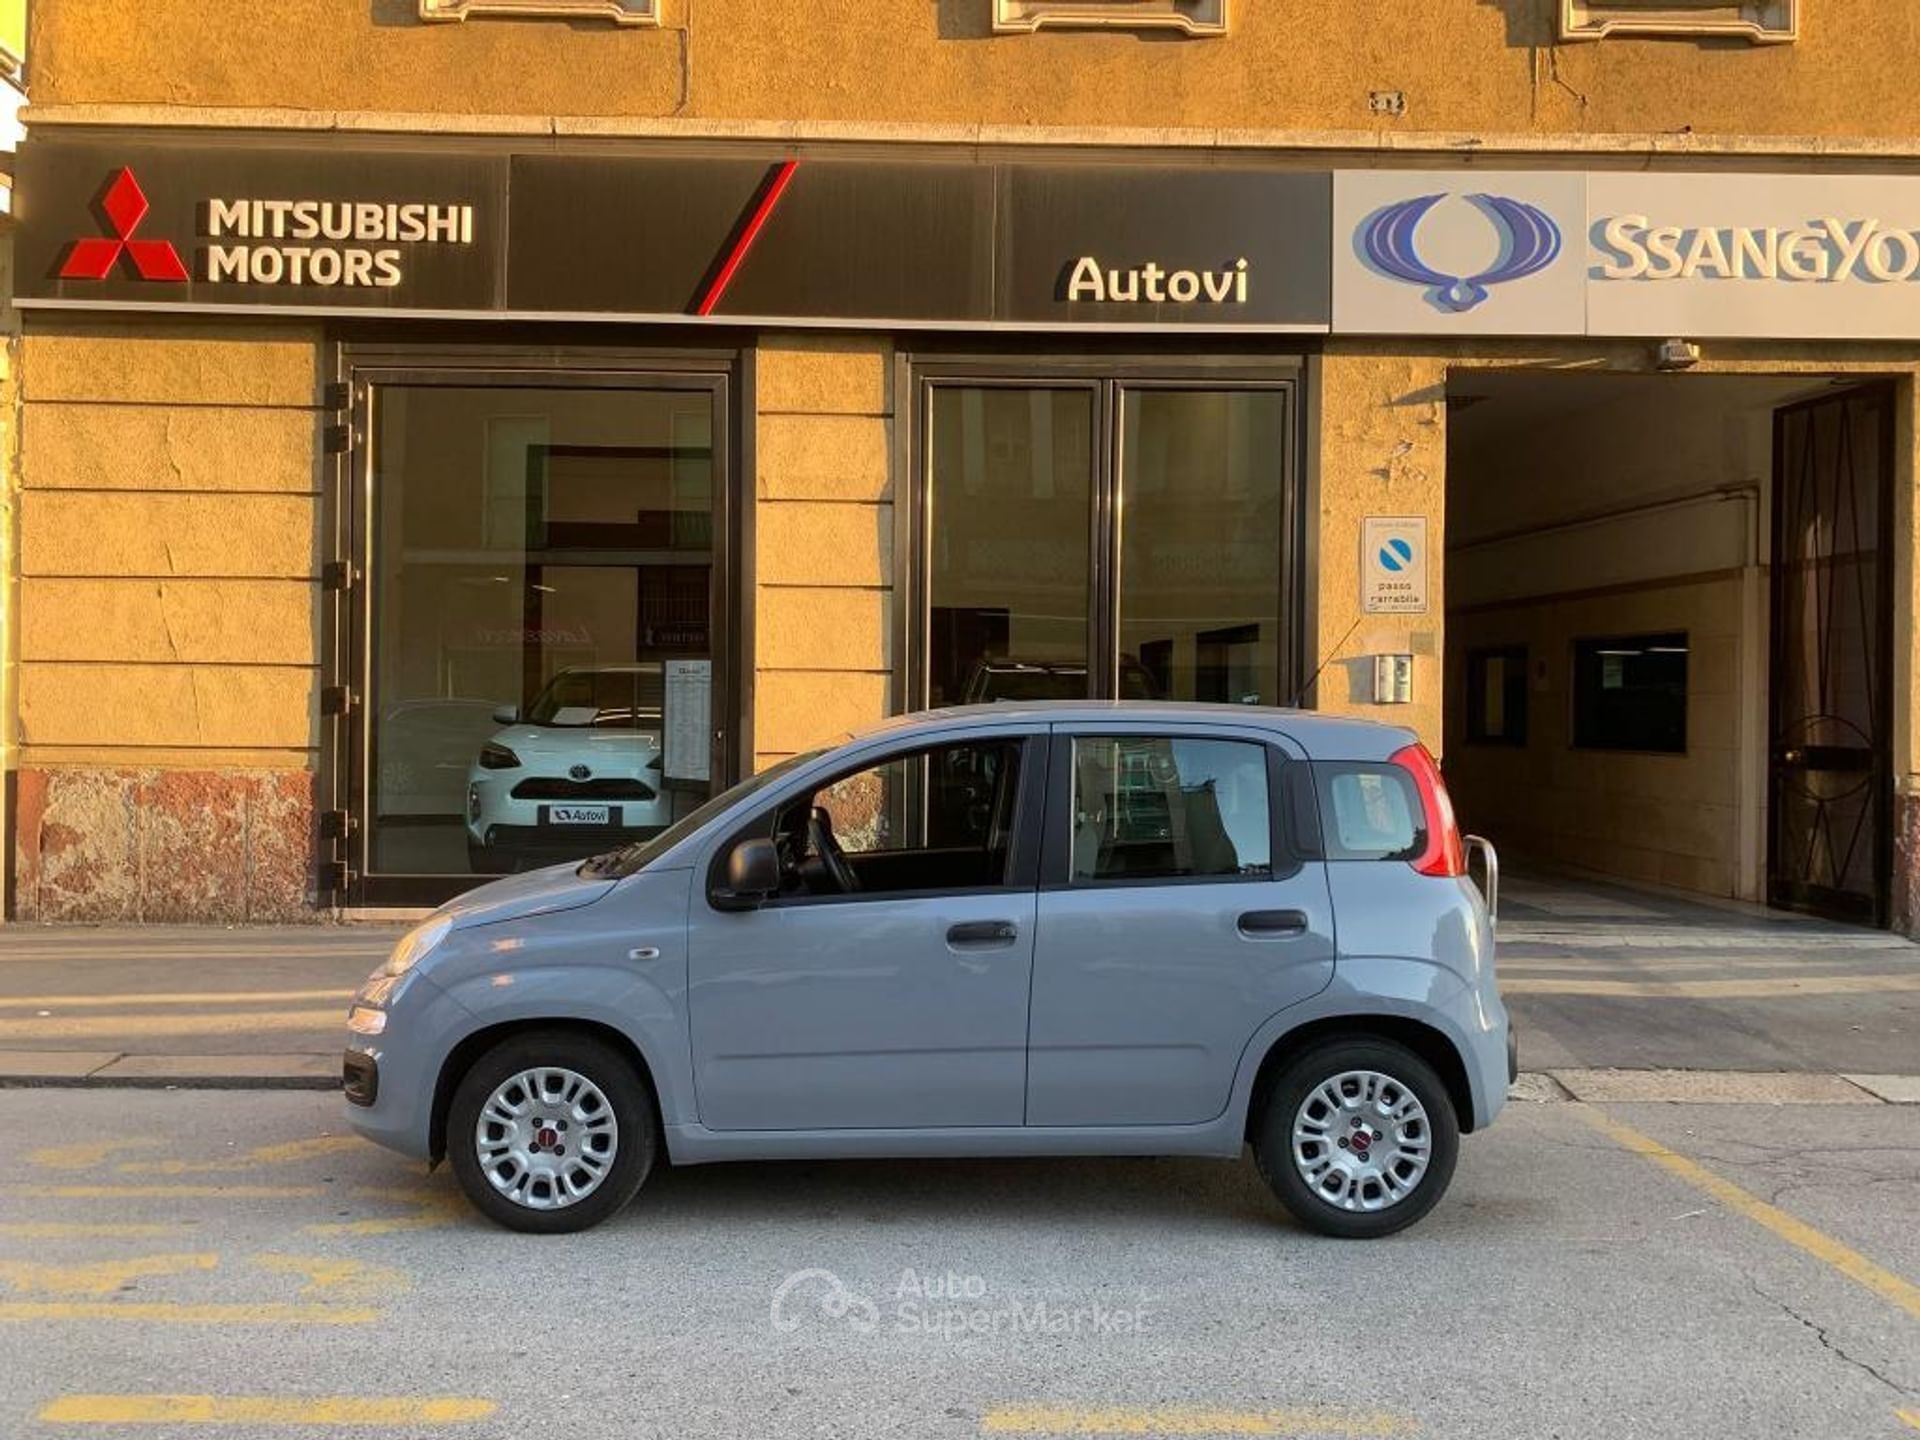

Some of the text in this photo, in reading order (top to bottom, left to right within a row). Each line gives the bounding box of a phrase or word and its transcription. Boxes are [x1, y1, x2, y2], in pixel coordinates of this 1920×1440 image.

[207, 198, 473, 245] MITSUBISHI
[207, 245, 401, 287] MOTORS
[1067, 256, 1248, 303] Autovi
